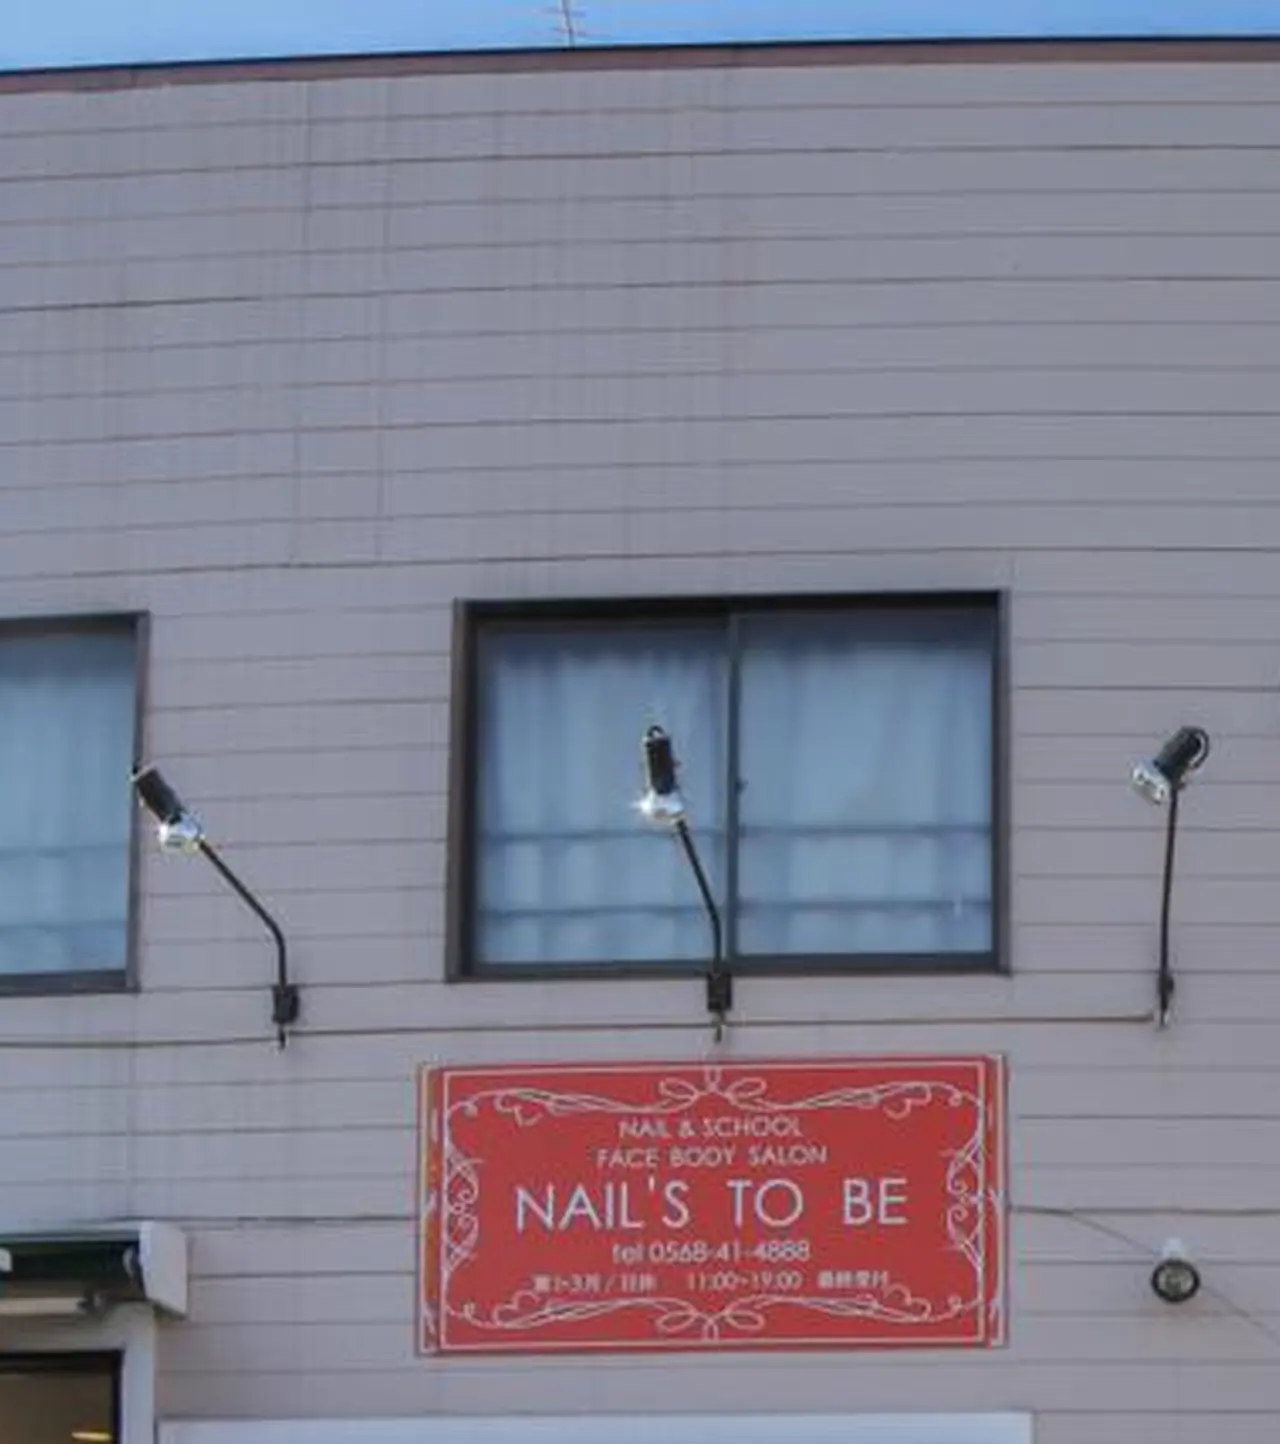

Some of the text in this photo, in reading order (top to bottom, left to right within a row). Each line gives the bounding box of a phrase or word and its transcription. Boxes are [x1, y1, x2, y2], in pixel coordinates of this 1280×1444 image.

[619, 1115, 804, 1138] NAIL & SCHOOL
[596, 1144, 827, 1169] FACE BODY SALON
[515, 1177, 908, 1231] NAIL'S TO BE
[612, 1240, 810, 1264] tel 0568-41-4888
